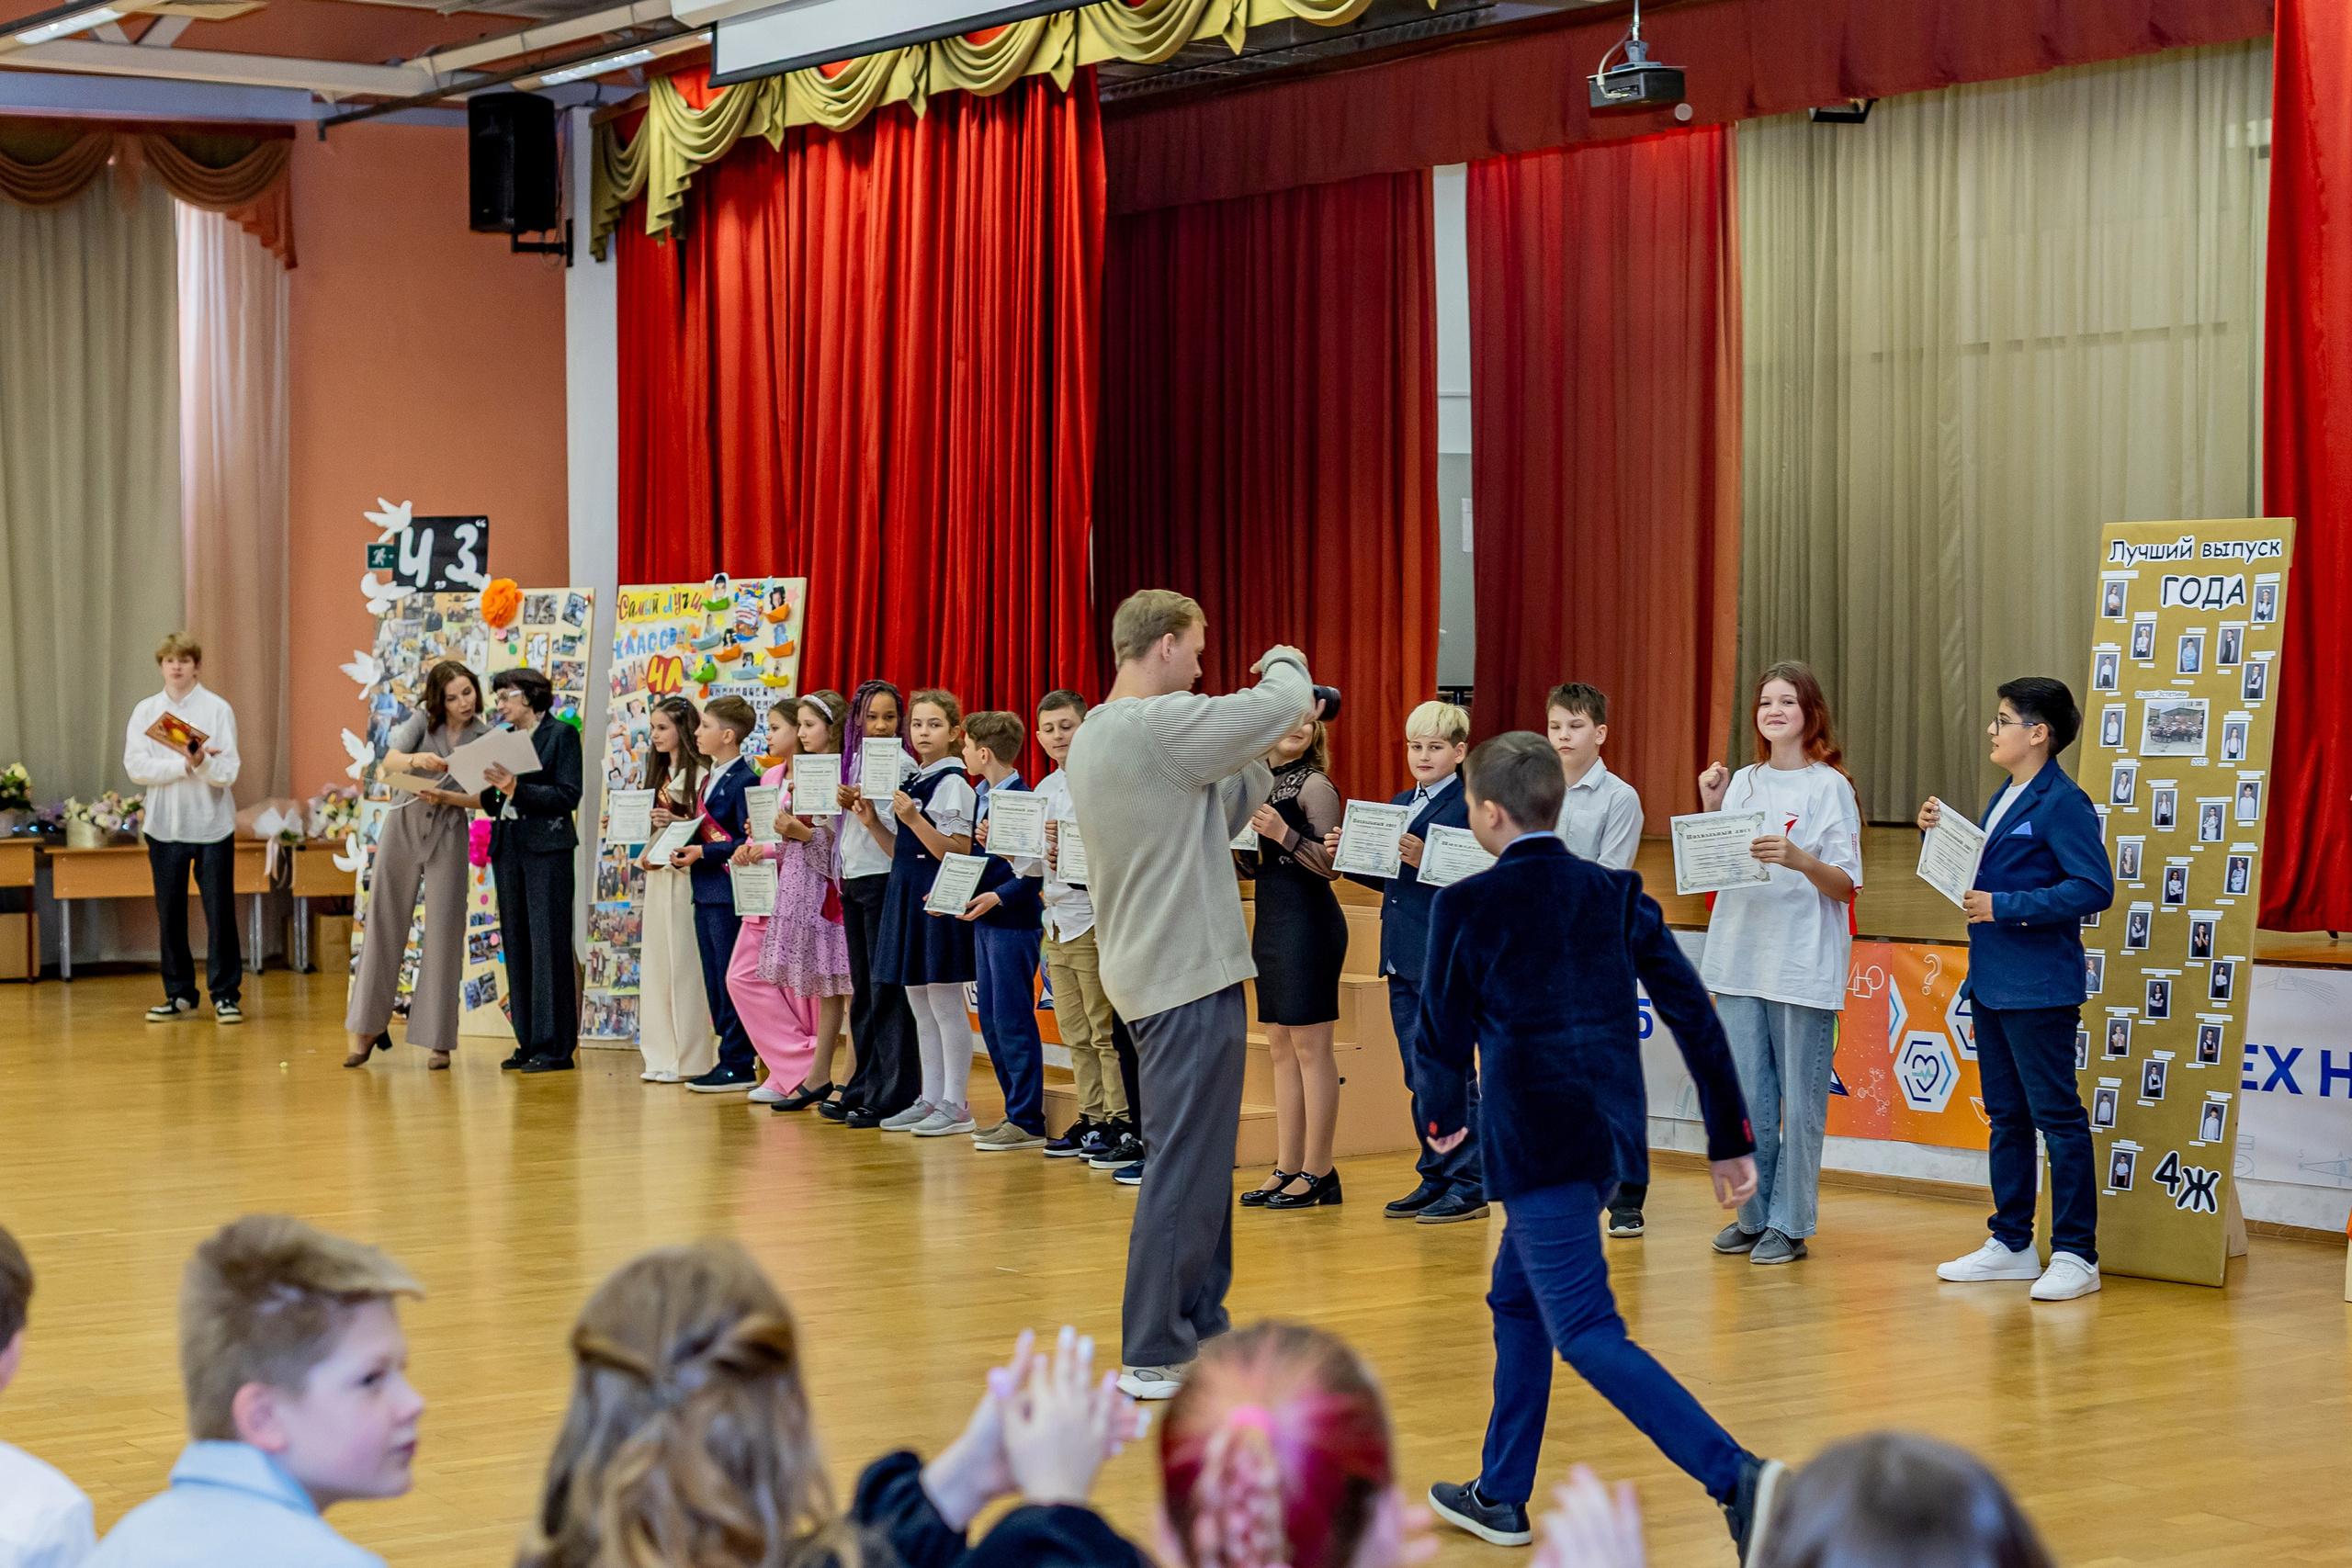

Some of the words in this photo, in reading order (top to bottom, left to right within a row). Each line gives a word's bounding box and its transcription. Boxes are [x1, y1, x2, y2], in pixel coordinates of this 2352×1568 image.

[2109, 537, 2193, 567] Лучший
[2201, 541, 2281, 564] выпуск
[2163, 577, 2245, 609] ГОДА
[2154, 1152, 2220, 1213] 4Ж
